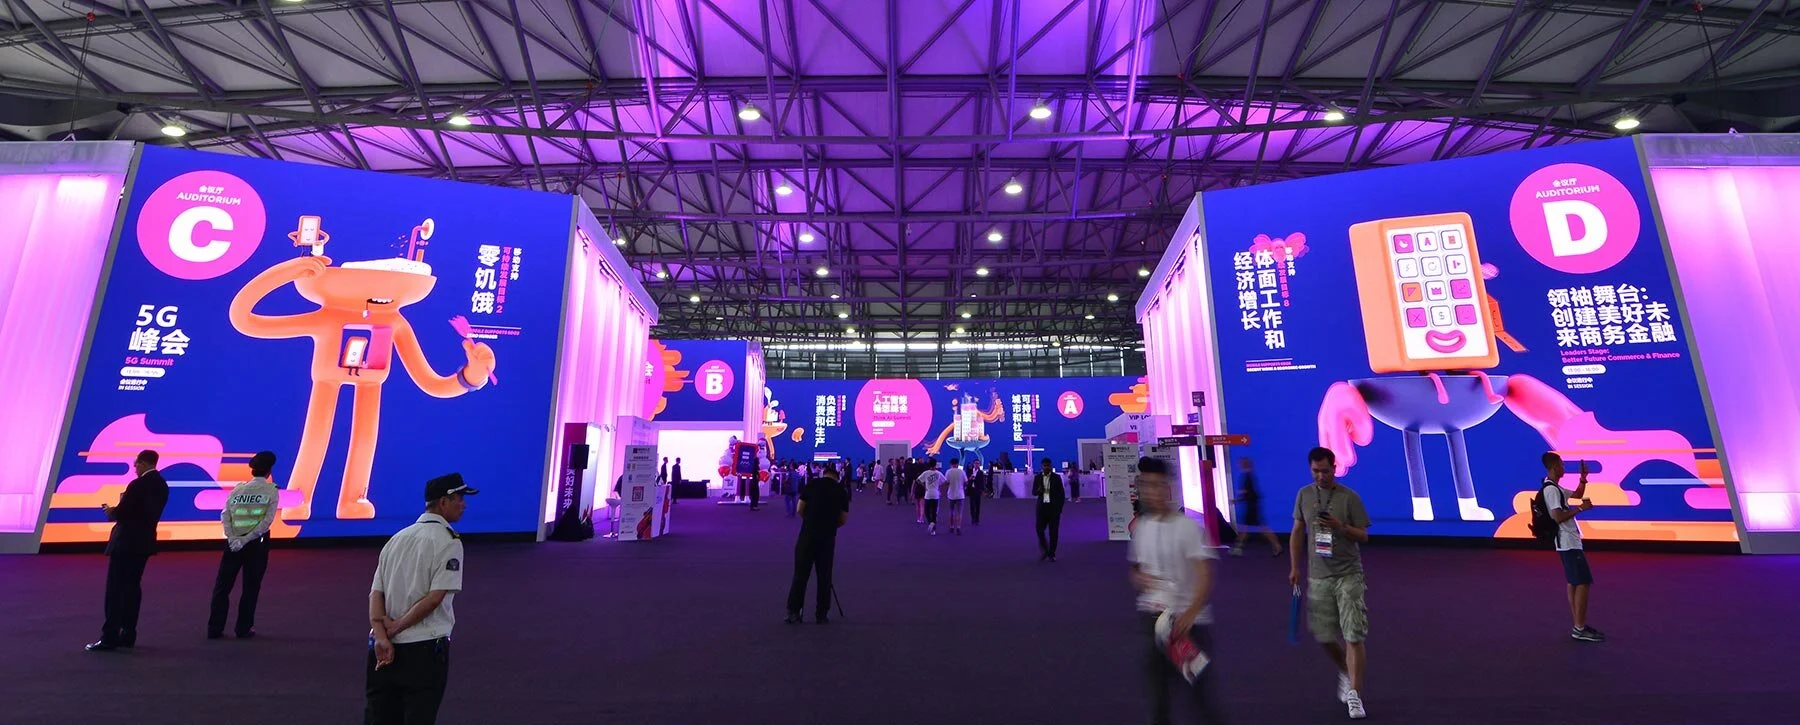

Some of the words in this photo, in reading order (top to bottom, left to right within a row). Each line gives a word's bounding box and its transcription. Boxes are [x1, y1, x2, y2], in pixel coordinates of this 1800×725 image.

[176, 192, 241, 206] AUDITORIUM
[1535, 185, 1600, 198] AUDITORIUM
[168, 205, 234, 263] C
[1541, 199, 1608, 257] D
[471, 244, 500, 314] 零饥饿
[1233, 251, 1261, 331] 经济增长
[1255, 248, 1286, 350] 体面工作和
[135, 304, 179, 328] 5G
[1551, 301, 1671, 328] 创建美好未
[128, 326, 191, 356] 峰会
[1556, 320, 1678, 347] 来商务金融
[125, 356, 139, 365] 5G
[139, 357, 175, 367] Summit
[1560, 349, 1587, 357] Leaders
[1588, 348, 1610, 356] Stage:
[1561, 356, 1583, 364] Better
[1584, 355, 1606, 363] Future
[1607, 353, 1645, 361] Commerce
[1652, 352, 1680, 360] Finance
[705, 373, 724, 395] B
[826, 394, 837, 427] 负责任
[1012, 394, 1023, 441] 城市和社区
[1022, 394, 1033, 423] 可持续
[1064, 399, 1078, 415] A
[814, 394, 826, 448] 消费和生产
[232, 494, 262, 504] SNIEC
